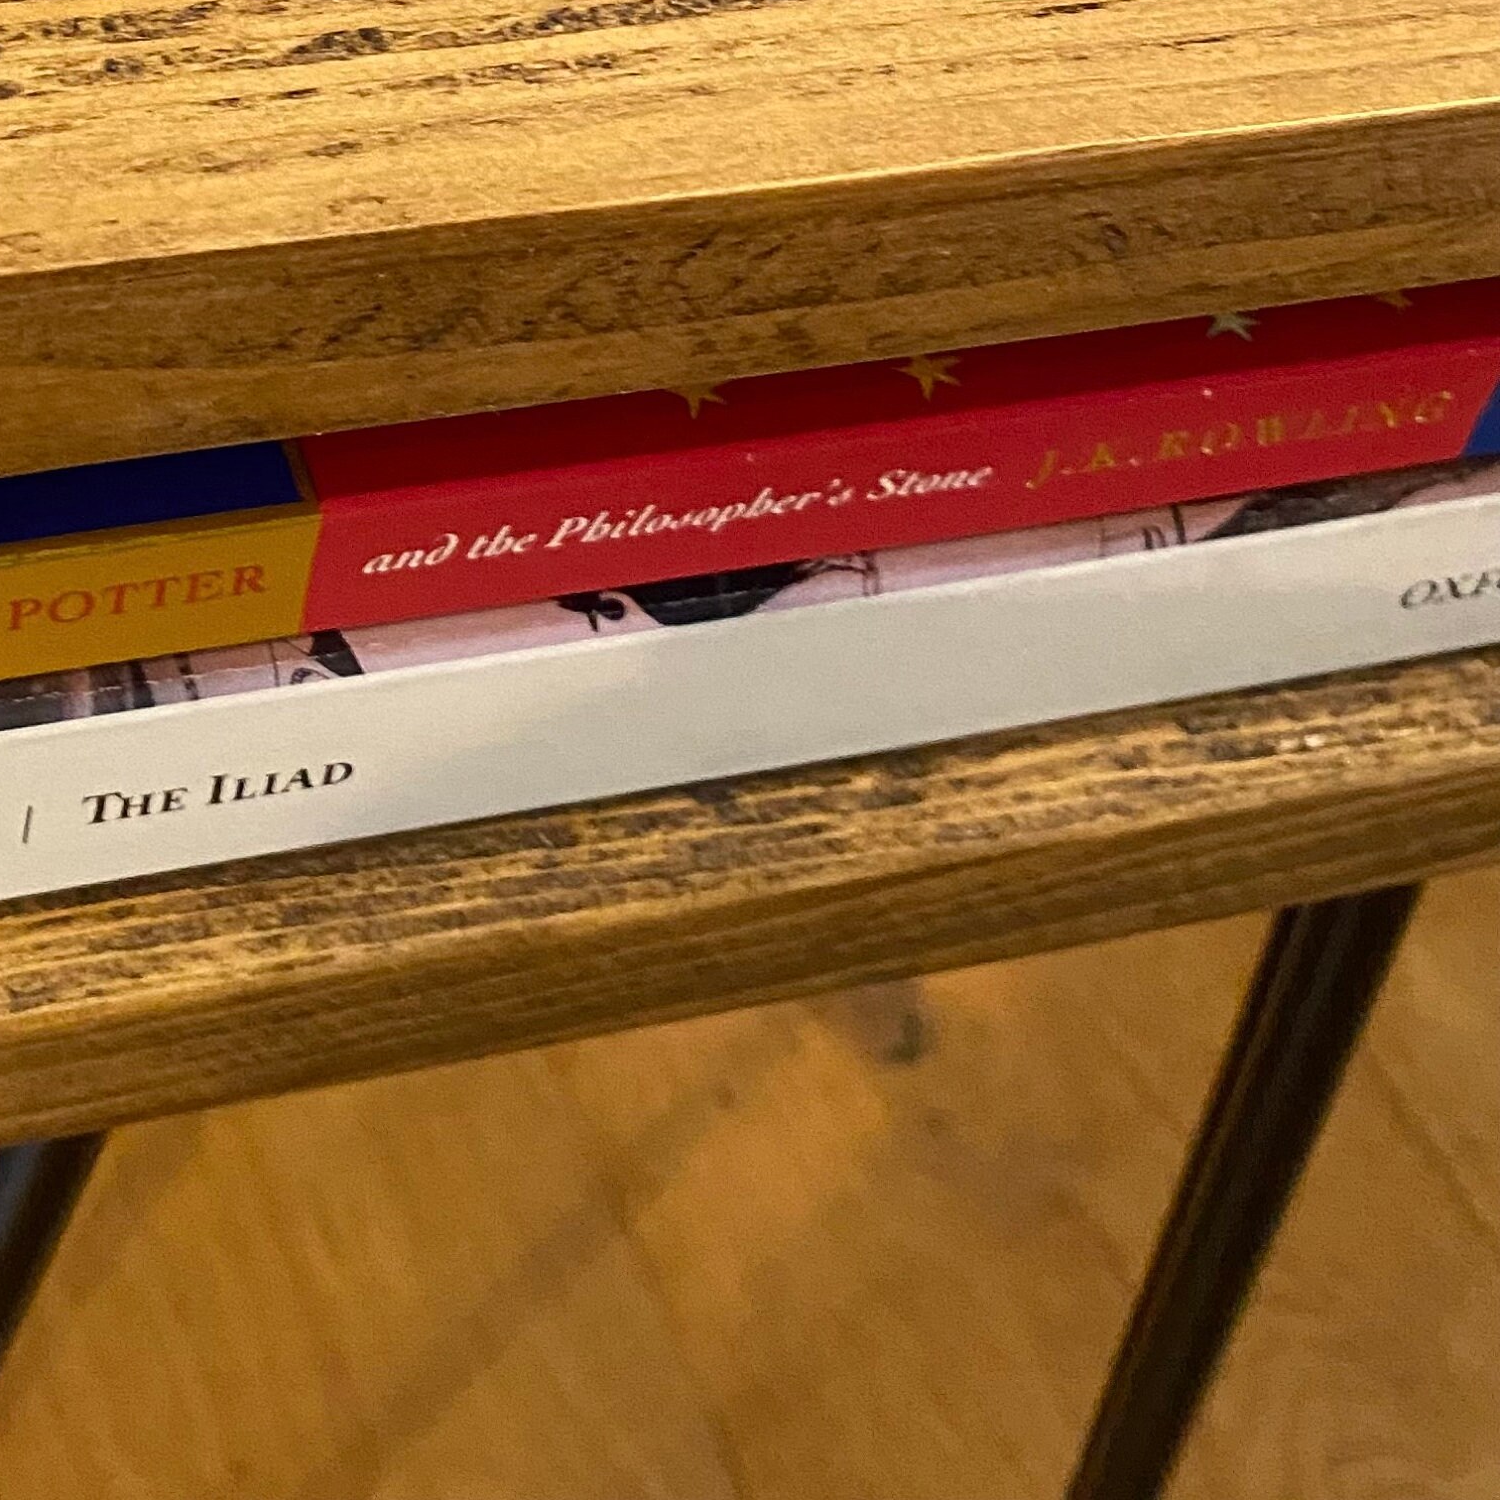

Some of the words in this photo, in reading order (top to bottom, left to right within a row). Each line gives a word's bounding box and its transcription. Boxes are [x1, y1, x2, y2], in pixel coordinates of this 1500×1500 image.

[8, 563, 267, 632] POTTER
[362, 532, 458, 575] and
[467, 523, 538, 561] the
[544, 478, 854, 549] Philosopher's
[866, 464, 995, 501] Stone
[1156, 390, 1454, 460] ROWLING
[81, 786, 189, 825] THE
[205, 760, 354, 807] ILIAD
[1399, 568, 1500, 609] OXF
